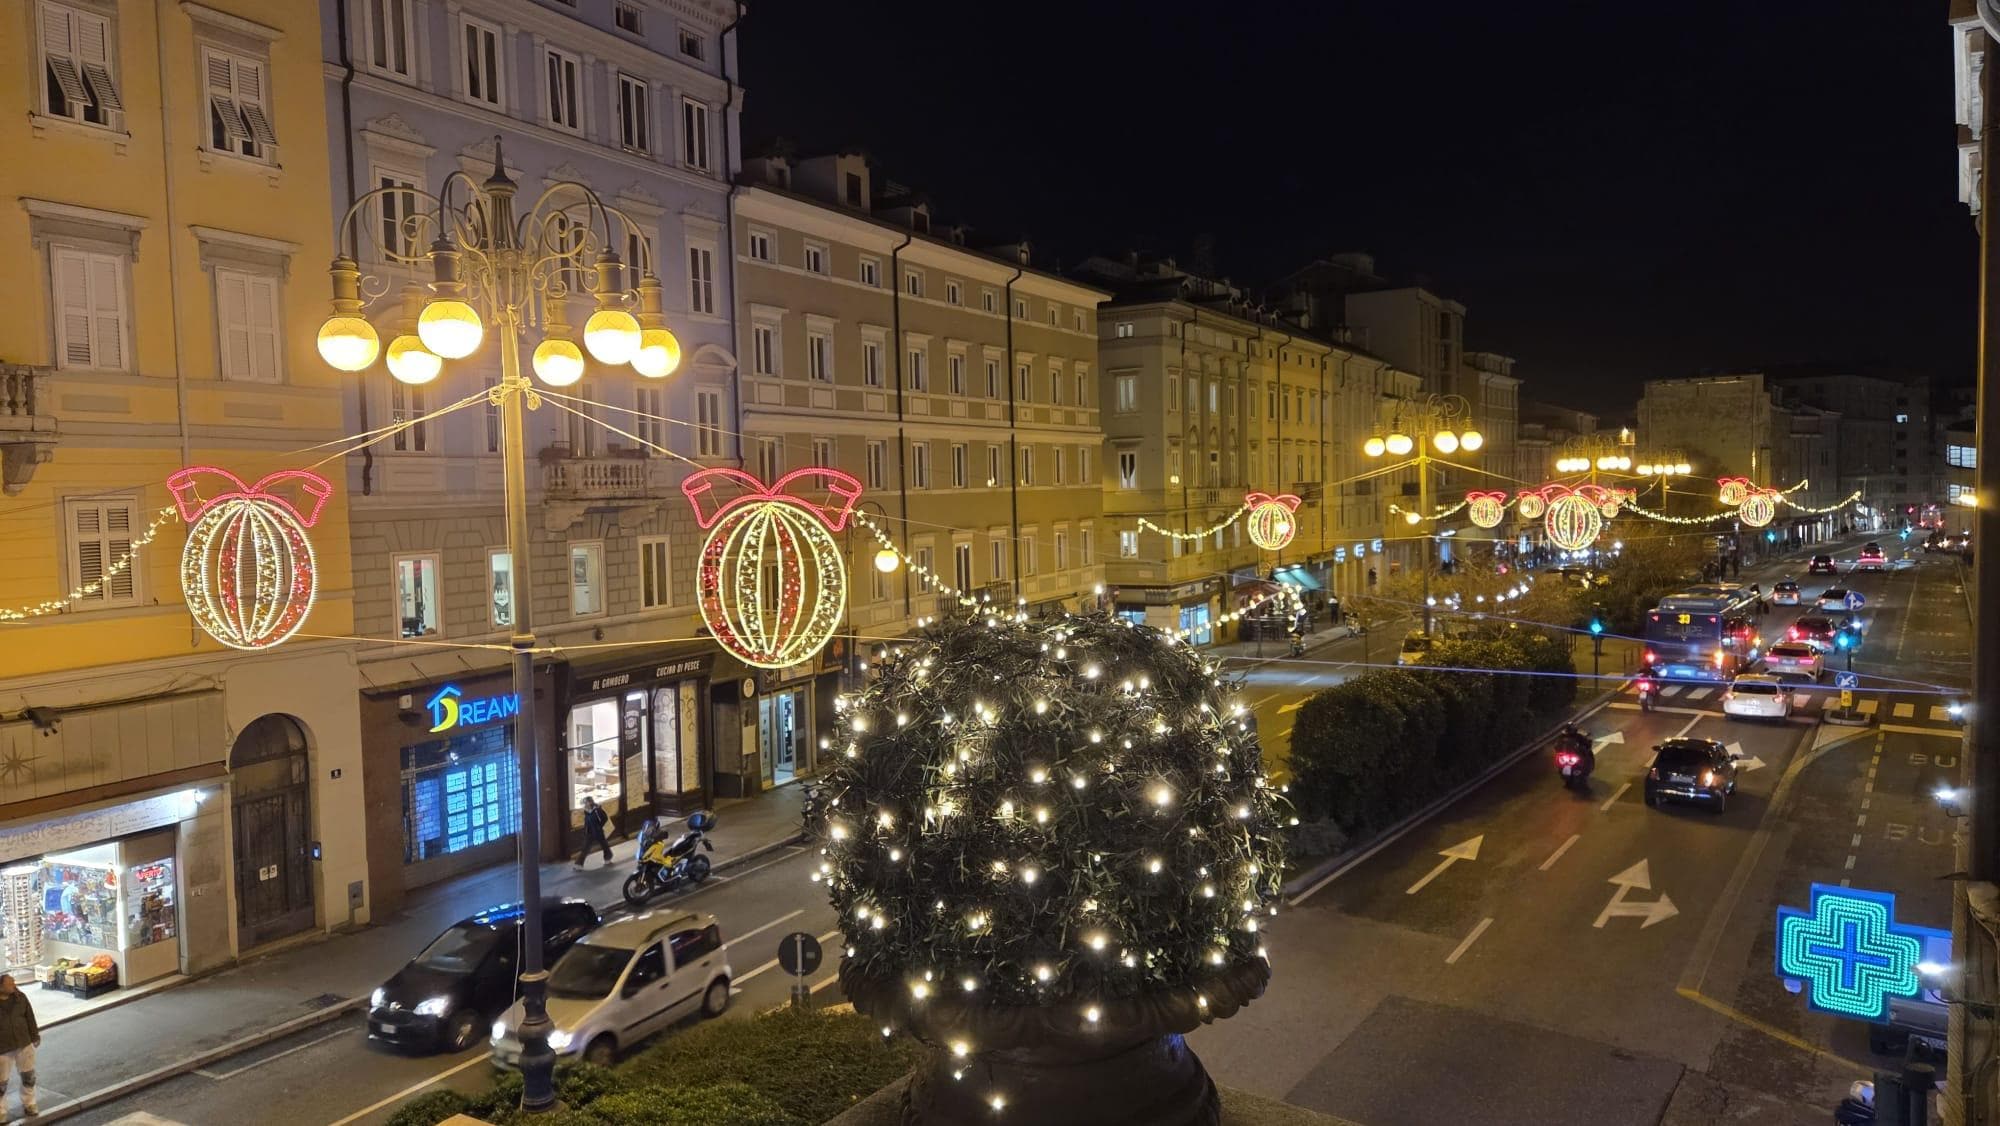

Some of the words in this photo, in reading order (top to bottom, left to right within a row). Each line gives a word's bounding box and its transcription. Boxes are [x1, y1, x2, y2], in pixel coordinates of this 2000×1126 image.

[656, 664, 676, 678] CUCINA
[684, 660, 700, 672] PESCE
[602, 674, 630, 689] GAMBERO
[427, 686, 519, 733] DREAM
